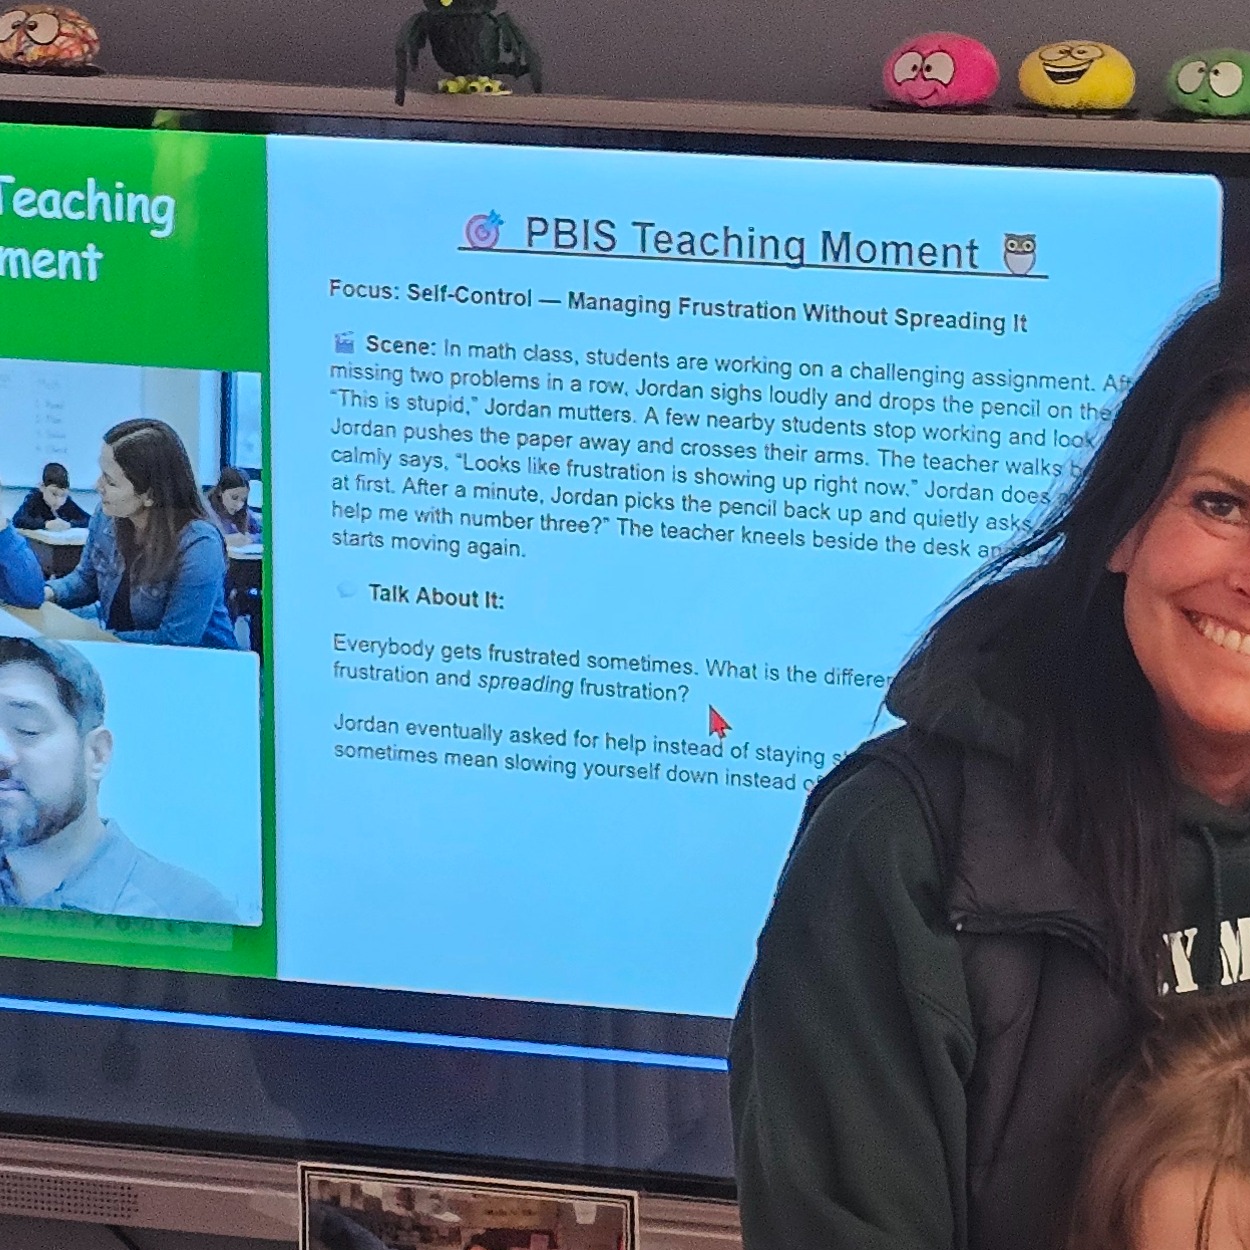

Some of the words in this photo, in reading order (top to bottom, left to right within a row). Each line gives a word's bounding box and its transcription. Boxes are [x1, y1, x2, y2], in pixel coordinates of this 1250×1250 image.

[526, 216, 617, 252] PBIS
[632, 221, 804, 268] Teaching
[820, 230, 979, 269] Moment
[330, 279, 399, 300] Focus:
[407, 284, 531, 306] Self-Control
[568, 291, 670, 319] Managing
[679, 297, 796, 320] Frustration
[803, 303, 888, 326] Without
[894, 308, 1005, 336] Spreading
[1014, 314, 1027, 333] It
[368, 583, 409, 603] Talk
[416, 587, 479, 608] About
[485, 591, 504, 610] It:
[334, 633, 435, 661] Everybody
[441, 644, 482, 664] gets
[489, 643, 583, 671] frustrated
[587, 655, 698, 675] sometimes.
[706, 659, 758, 680] What
[765, 663, 780, 681] is
[787, 664, 817, 683] the
[334, 661, 429, 684] frustration
[435, 669, 471, 688] and
[477, 674, 574, 699] spreading
[580, 677, 689, 702] frustration?
